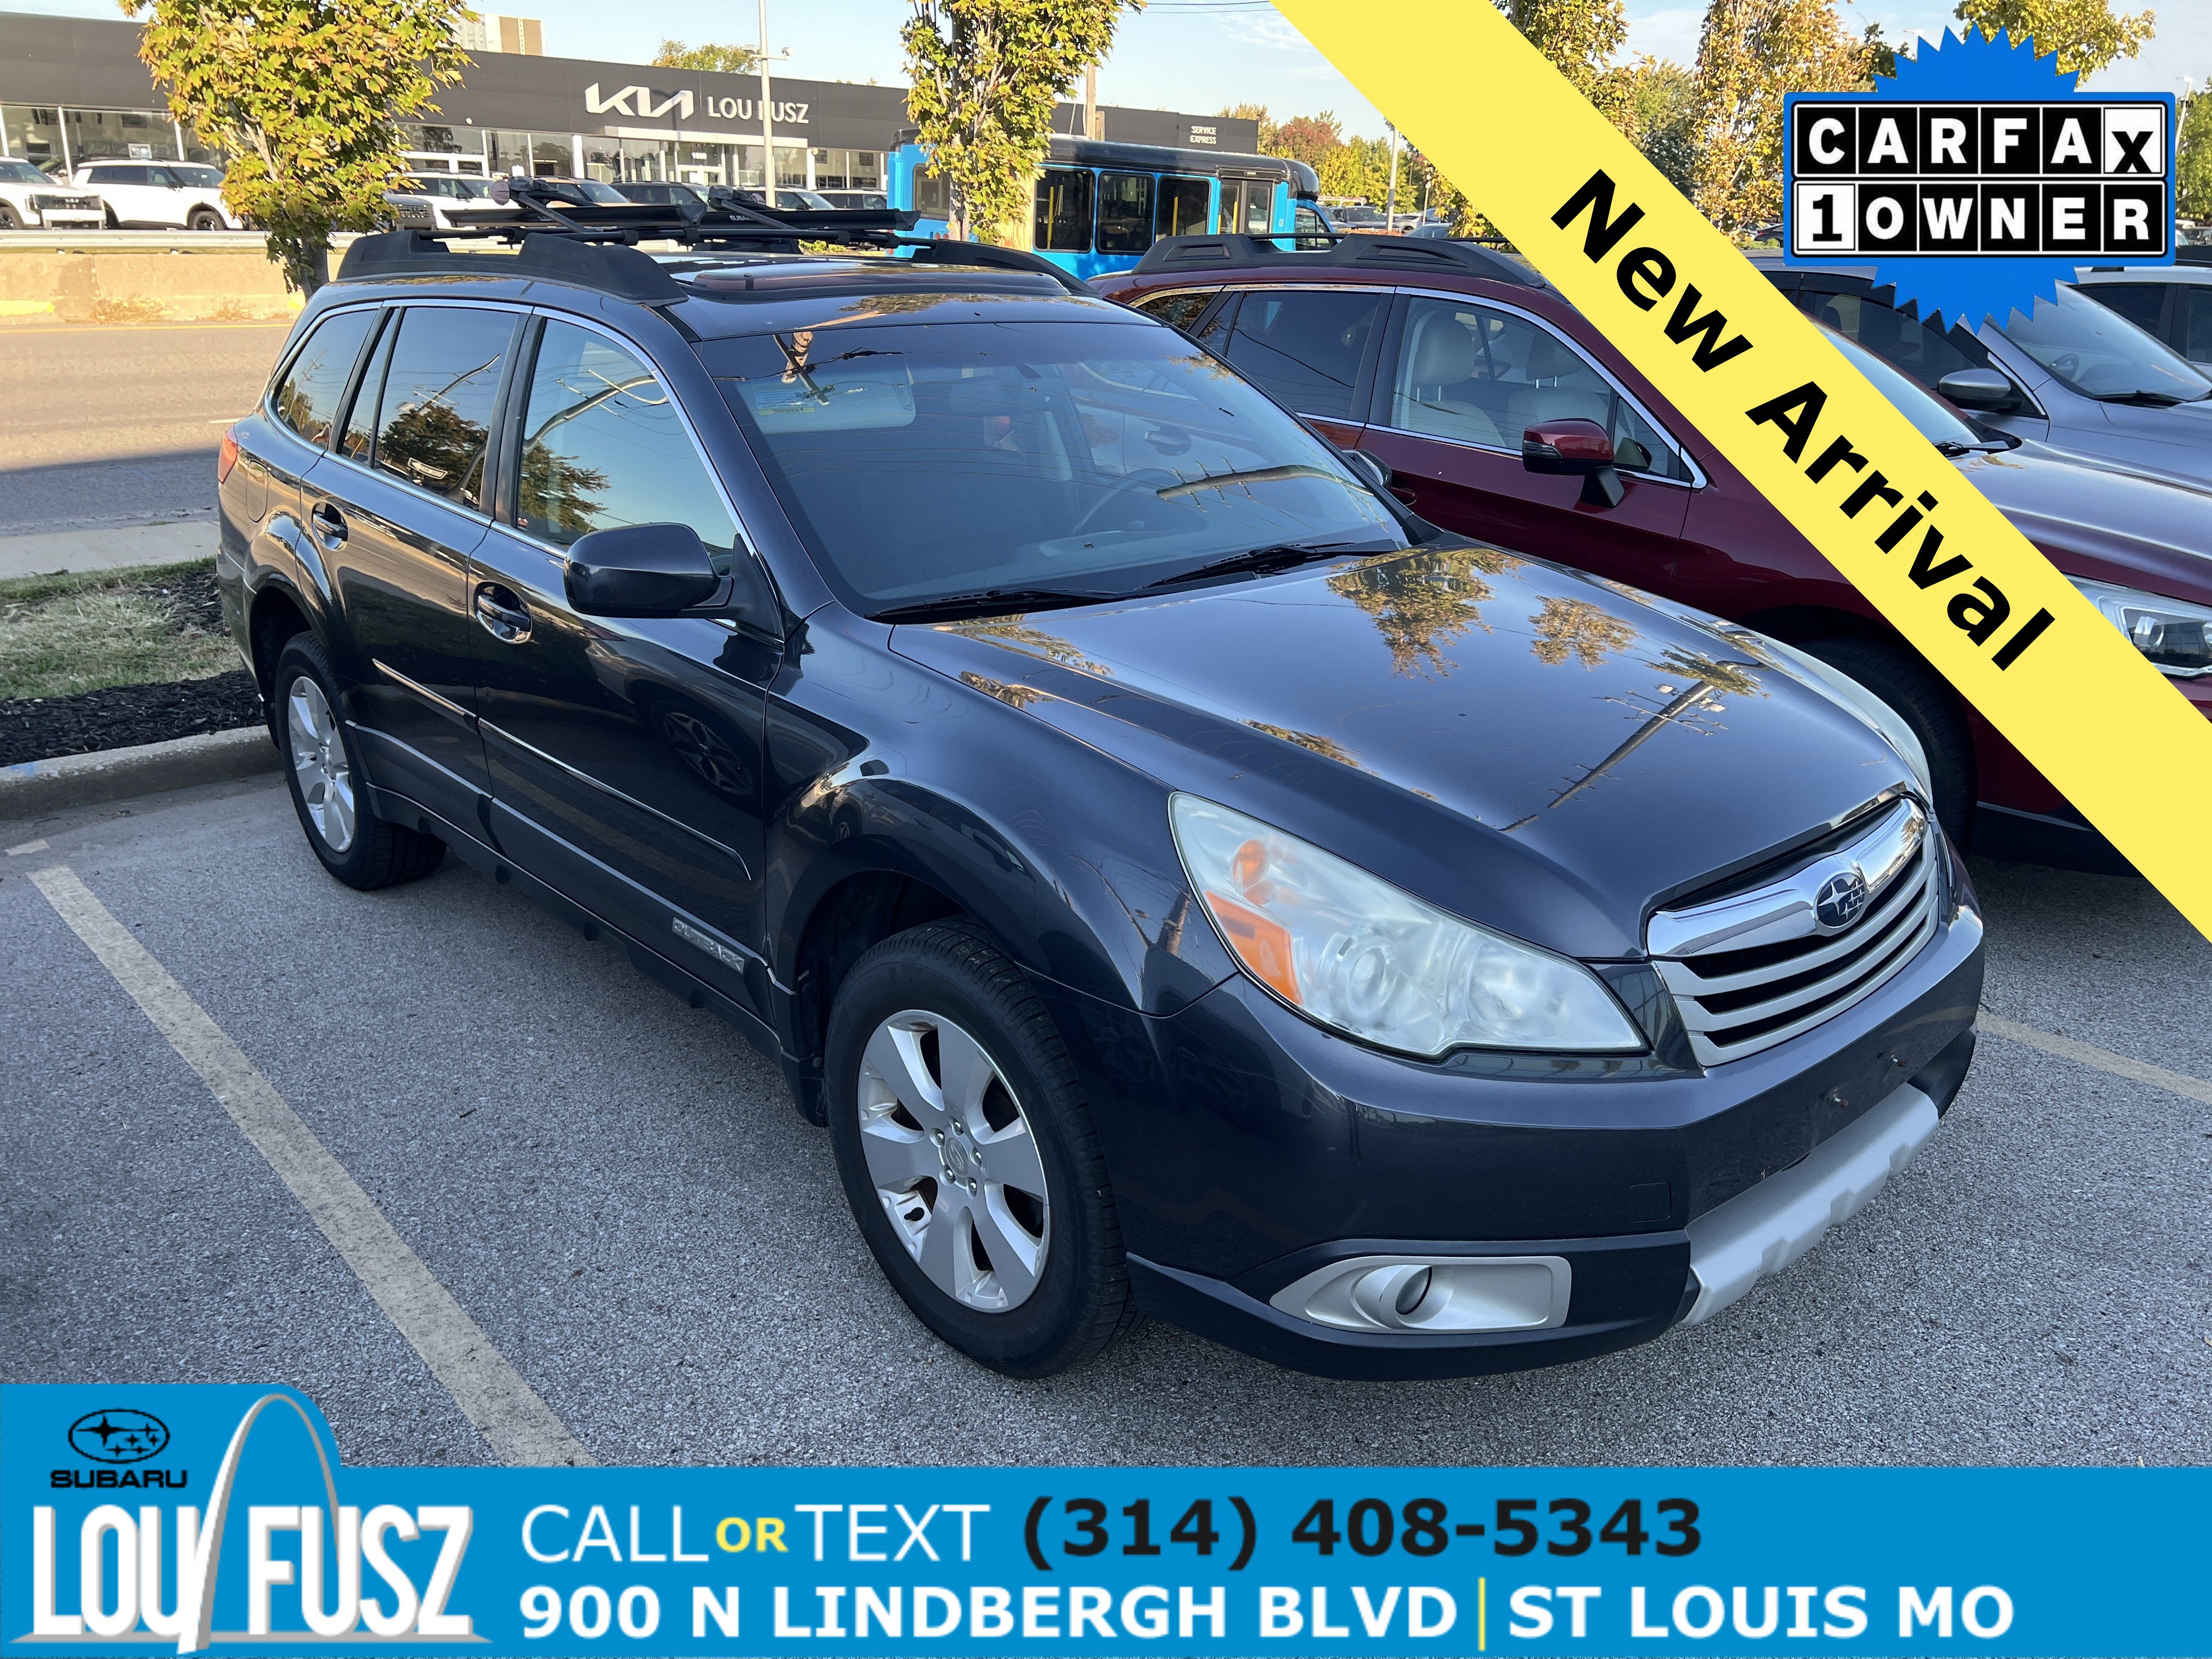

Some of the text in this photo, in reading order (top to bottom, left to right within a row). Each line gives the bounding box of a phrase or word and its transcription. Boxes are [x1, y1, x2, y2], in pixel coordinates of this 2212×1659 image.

[585, 82, 694, 120] KIA
[707, 96, 752, 120] LOU
[1190, 126, 1217, 135] SERVICE
[1189, 134, 1217, 145] EXPRESS
